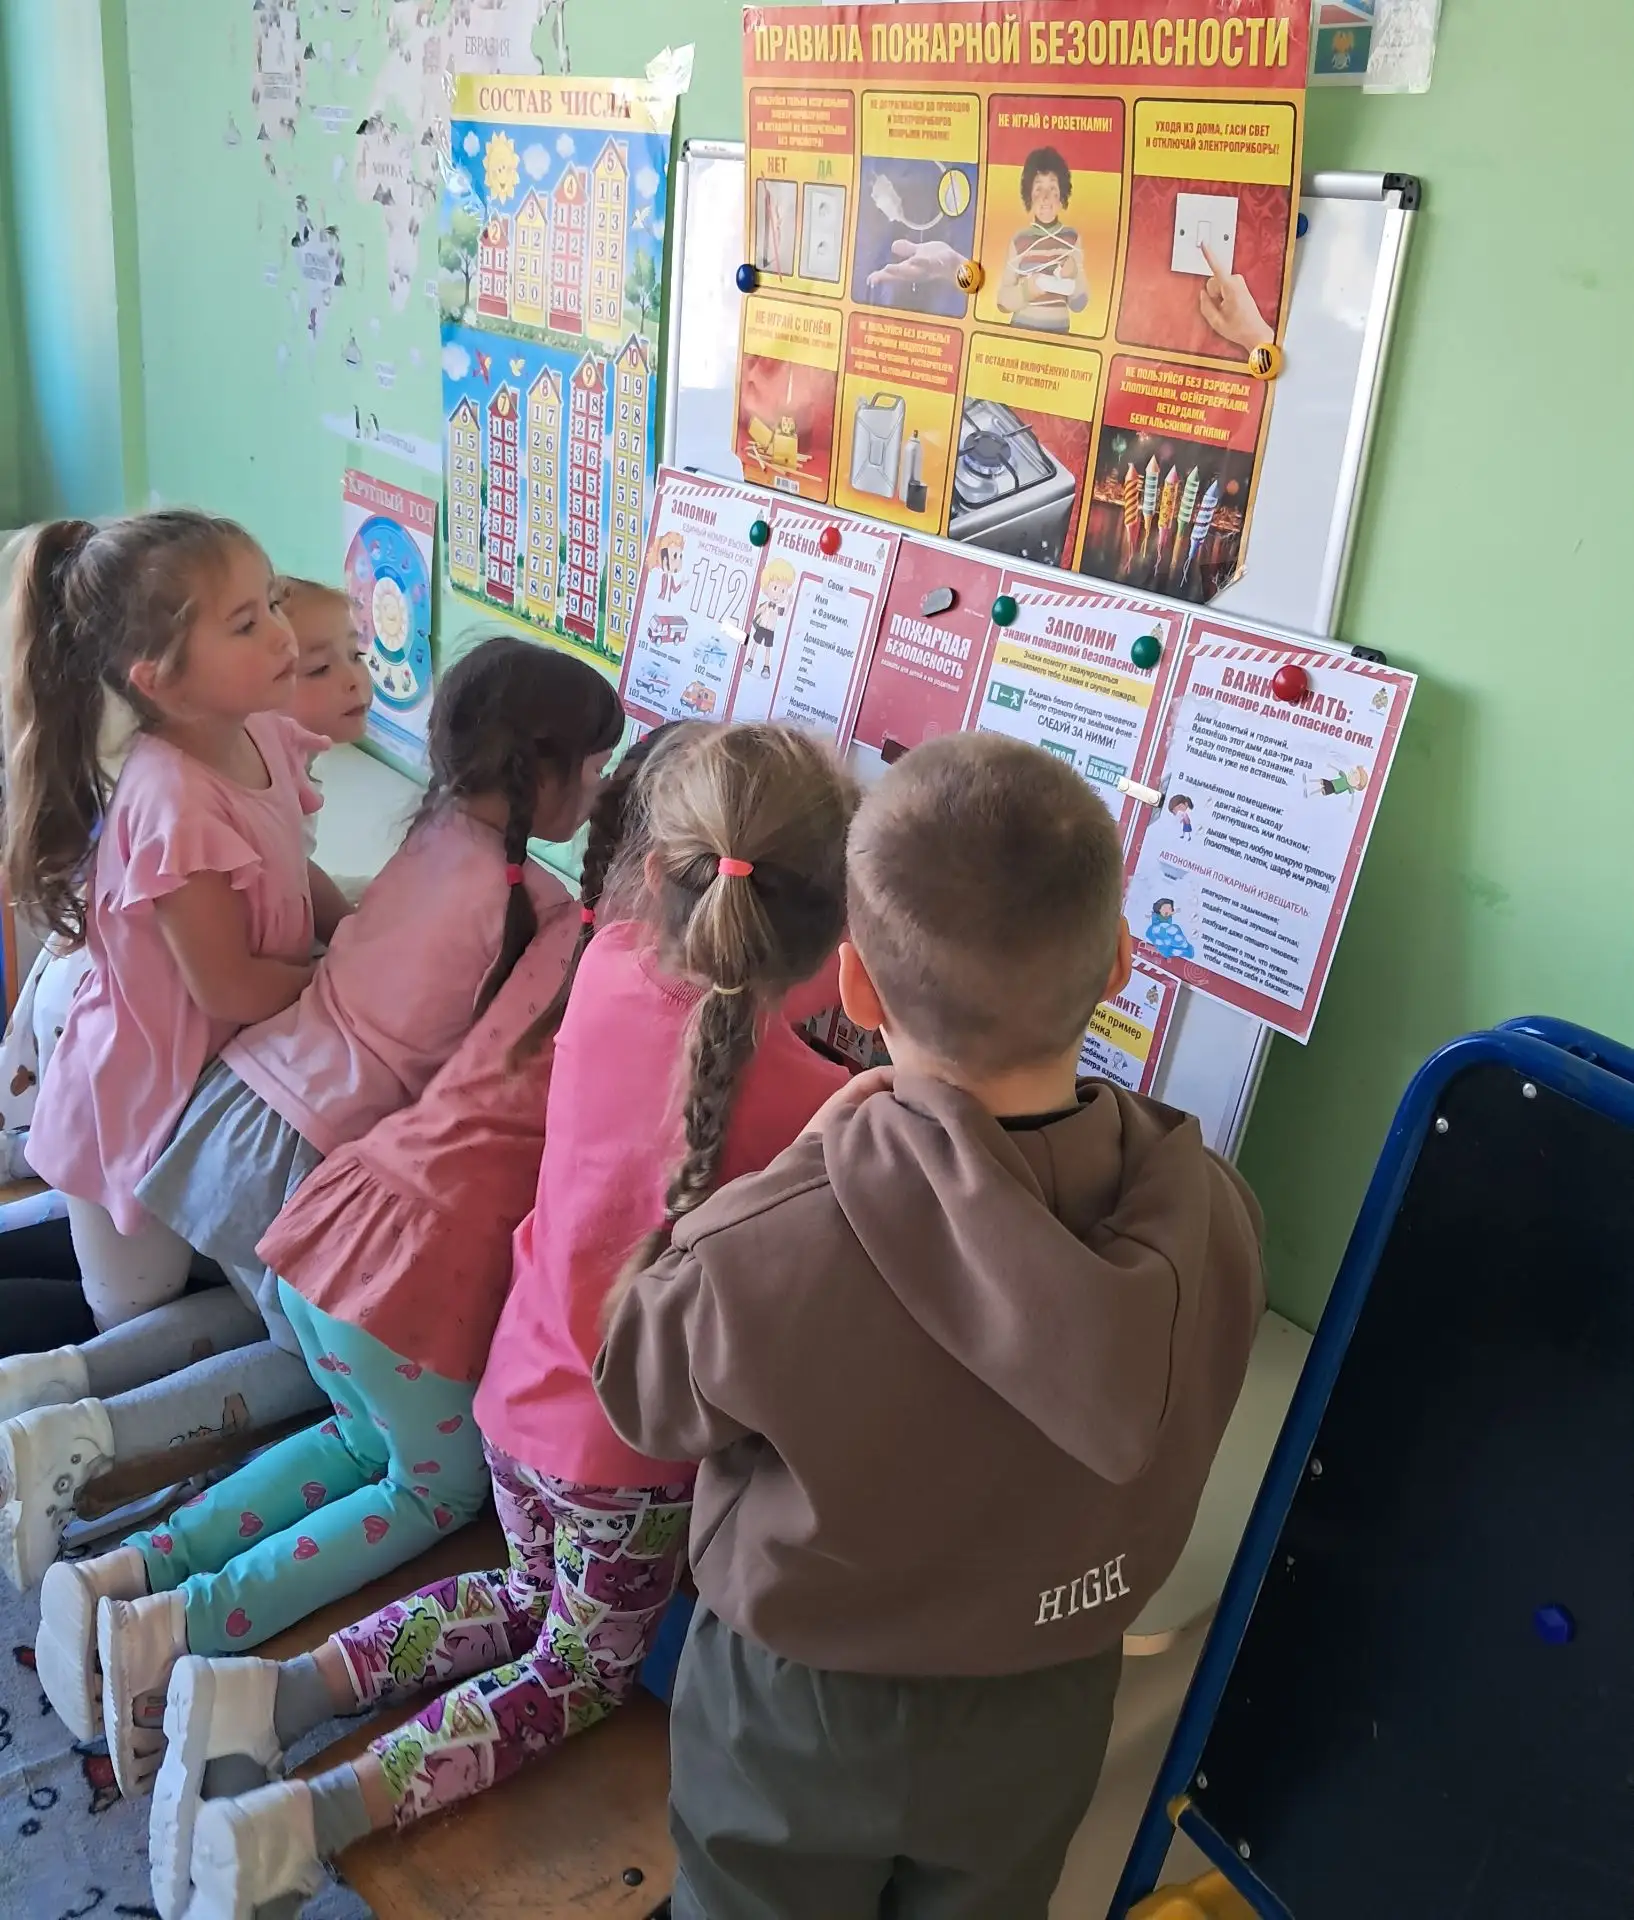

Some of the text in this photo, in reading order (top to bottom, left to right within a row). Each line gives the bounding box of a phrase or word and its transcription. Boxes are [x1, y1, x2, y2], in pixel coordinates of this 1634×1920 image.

[755, 15, 1289, 67] ПРАВИЛА ПОЖАРНОЙ БЕЗОПАСНОСТИ
[480, 87, 631, 118] СОСТАВ ЧИСЛА
[997, 113, 1113, 132] НЕ ИГРАЙ С РОЗЕТКАМИ!
[1154, 121, 1270, 137] УХОДЯ ИЗ ДОМА, ГАСИ СВЕТ
[1145, 137, 1281, 154] И ОТКЛЮЧАЙ ЭЛЕКТРОПРИБОРЫ!
[608, 153, 614, 171] 5
[767, 156, 832, 178] НЕТ ДА
[601, 183, 621, 196] 1 4
[599, 212, 618, 231] 2 3
[598, 240, 617, 259] 3 2
[596, 271, 615, 289] 4 1
[595, 299, 616, 317] 5 0
[756, 310, 766, 324] НЕ
[795, 319, 801, 331] С
[803, 319, 832, 335] ОГНЁМ
[1125, 365, 1250, 397] НЕ ПОЛЬЗУЙСЯ БЕЗ ВЗРОСЛЫХ
[1120, 380, 1250, 413] ХЛОПУШКАМИ, ФЕЙЕРВЕРКАМИ,
[1129, 412, 1230, 442] БЕНГАЛЬСКИМИ ОГНЯМИ!
[348, 475, 435, 527] КРУГЛЫЙ ГОД
[671, 499, 716, 525] ЗАПОМНИ
[854, 560, 876, 575] ЗНАТЬ
[686, 555, 749, 627] 112
[827, 579, 844, 592] Свои
[814, 593, 829, 605] Имя
[812, 607, 817, 615] и
[817, 608, 850, 627] Фамилию,
[637, 639, 648, 650] 101
[803, 632, 854, 658] Домашний адрес
[888, 613, 972, 660] ПОЖАРНАЯ
[1032, 634, 1080, 657] пожарной
[1045, 616, 1117, 650] ЗАПОМНИ
[693, 663, 706, 676] 102
[883, 638, 966, 679] БЕЗОПАСНОСТЬ
[628, 687, 639, 698] 103
[1221, 666, 1354, 723] ВАЖН НАТЬ:
[789, 696, 838, 723] Номера телефонов
[1191, 682, 1375, 750] при пожаре дым опаснее огня.
[1037, 713, 1116, 748] СЛЕДУЙ ЗА НИМИ!
[1194, 711, 1288, 750] Дым ядовитый и горячий.
[1188, 733, 1295, 777] и сразу потеряешь сознание.
[1192, 722, 1312, 771] Вдохнёшь этот дым два-три раза
[1186, 744, 1287, 787] Упадёшь и уже не встанешь.
[1178, 770, 1283, 818] В задымлённом помещении:
[1215, 799, 1282, 831] двигайся к выходу
[1160, 847, 1211, 878] АВТОНОМНЫЙ
[1213, 869, 1256, 896] ПОЖАРНЫЙ
[1108, 1016, 1141, 1040] пример
[1034, 1553, 1131, 1626] HIGH
